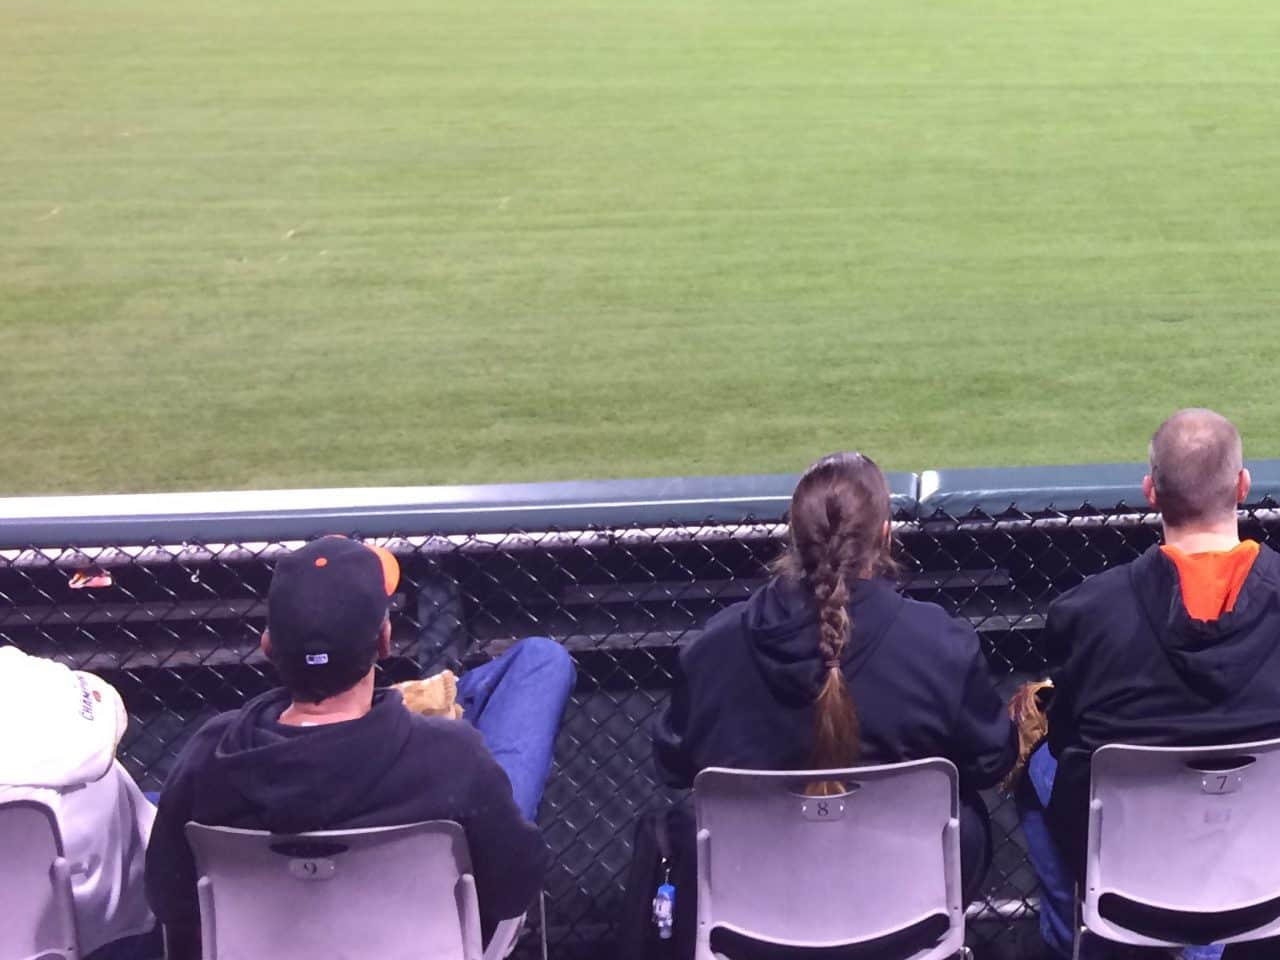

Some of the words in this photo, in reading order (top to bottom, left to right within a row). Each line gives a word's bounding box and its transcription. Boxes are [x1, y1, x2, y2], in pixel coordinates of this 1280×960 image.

[1216, 775, 1227, 790] 7
[817, 802, 829, 816] 8
[303, 862, 317, 876] 9
